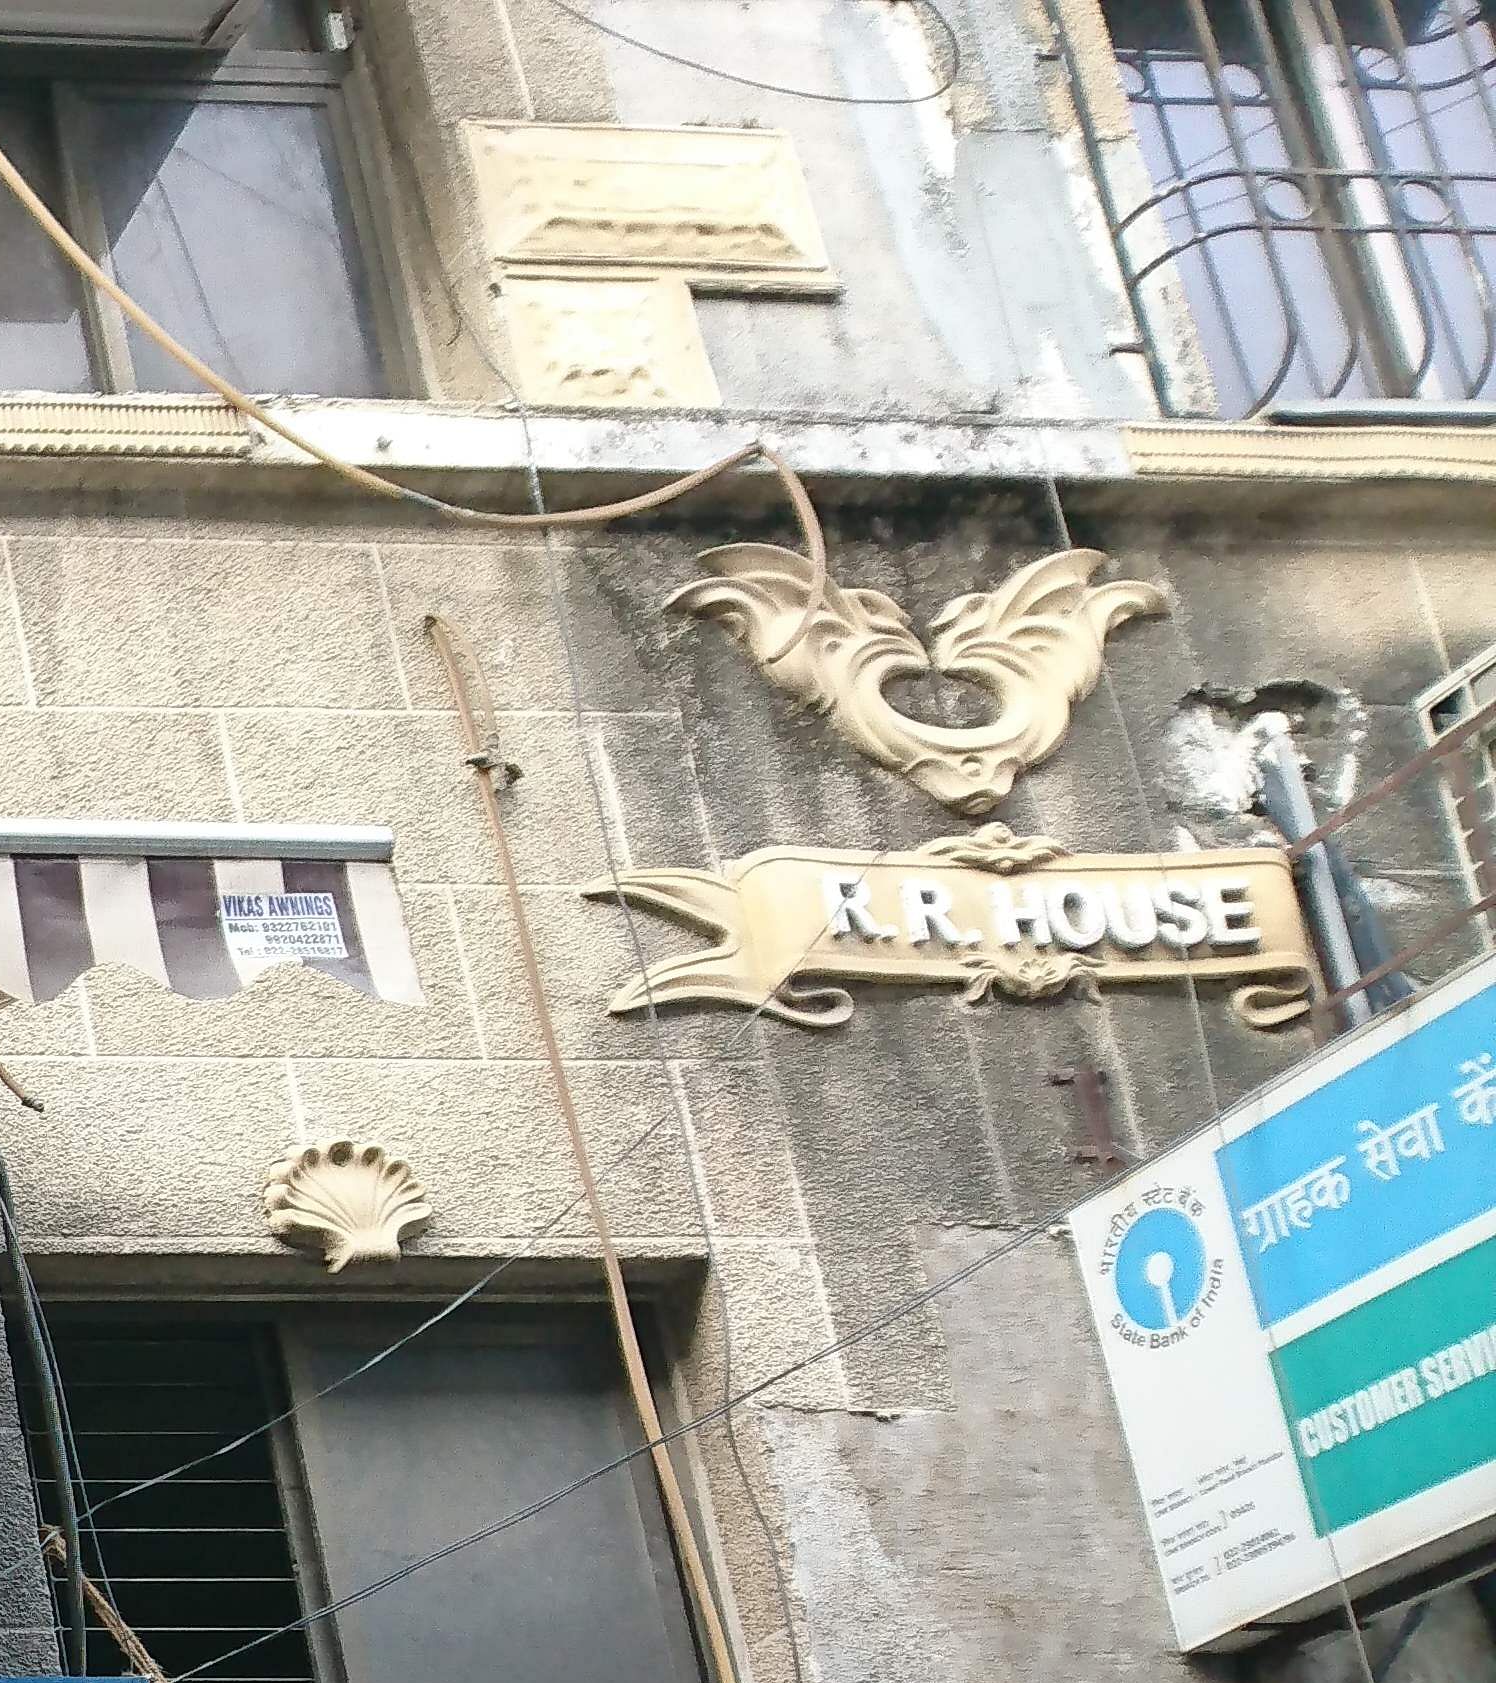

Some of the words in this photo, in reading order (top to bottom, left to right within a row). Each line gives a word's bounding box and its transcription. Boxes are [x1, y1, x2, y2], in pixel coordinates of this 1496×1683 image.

[223, 895, 263, 917] VIKAS
[268, 895, 333, 917] AWNINGS
[228, 921, 259, 934] Mob:
[985, 878, 1261, 955] HOUSE
[1241, 1154, 1351, 1254] ग्राहक
[1356, 1102, 1446, 1180] सेवा
[1111, 1313, 1147, 1347] State
[1150, 1325, 1189, 1349] Bank
[1190, 1308, 1206, 1328] of
[1202, 1258, 1224, 1307] India
[1297, 1366, 1426, 1458] CUSTOMER
